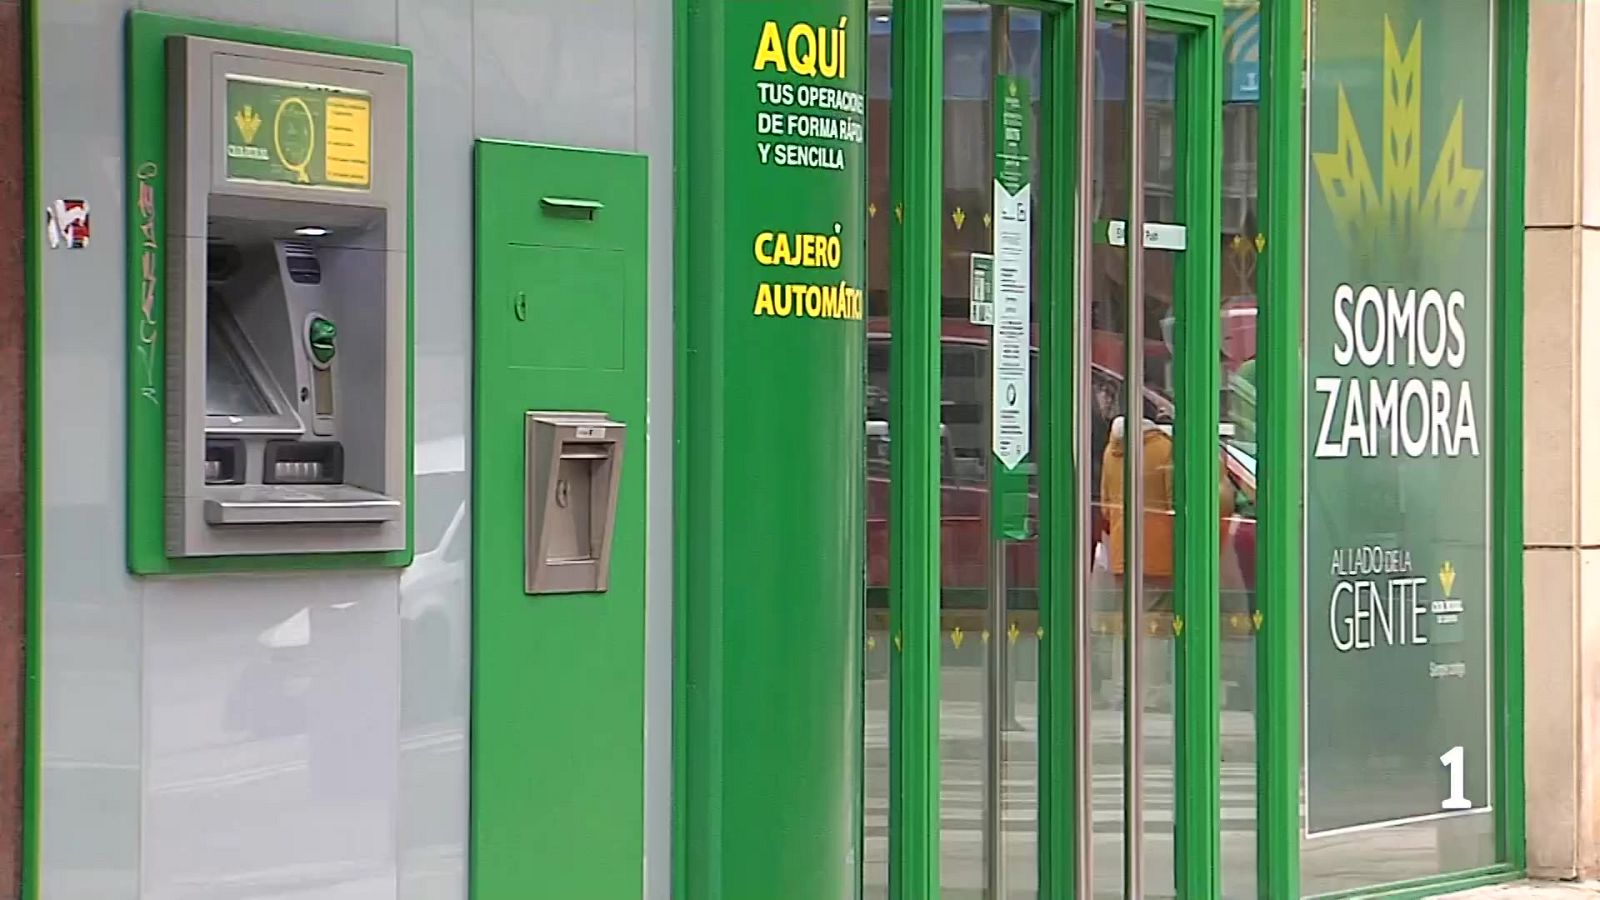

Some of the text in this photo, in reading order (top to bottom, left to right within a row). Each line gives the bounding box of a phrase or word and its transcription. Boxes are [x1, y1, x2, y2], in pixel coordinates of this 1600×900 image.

[753, 16, 848, 79] AQUÍ
[757, 82, 794, 104] TUS
[758, 112, 784, 134] DE
[787, 114, 838, 139] FORMA
[757, 142, 845, 170] Y SENCILLA
[754, 232, 841, 268] CAJERO
[754, 280, 863, 321] AUTOMÁTIC
[1333, 283, 1466, 368] SOMOS
[1314, 377, 1480, 458] ZAMORA
[1331, 546, 1413, 575] AL LADO DE LA
[1330, 577, 1428, 651] GENTE
